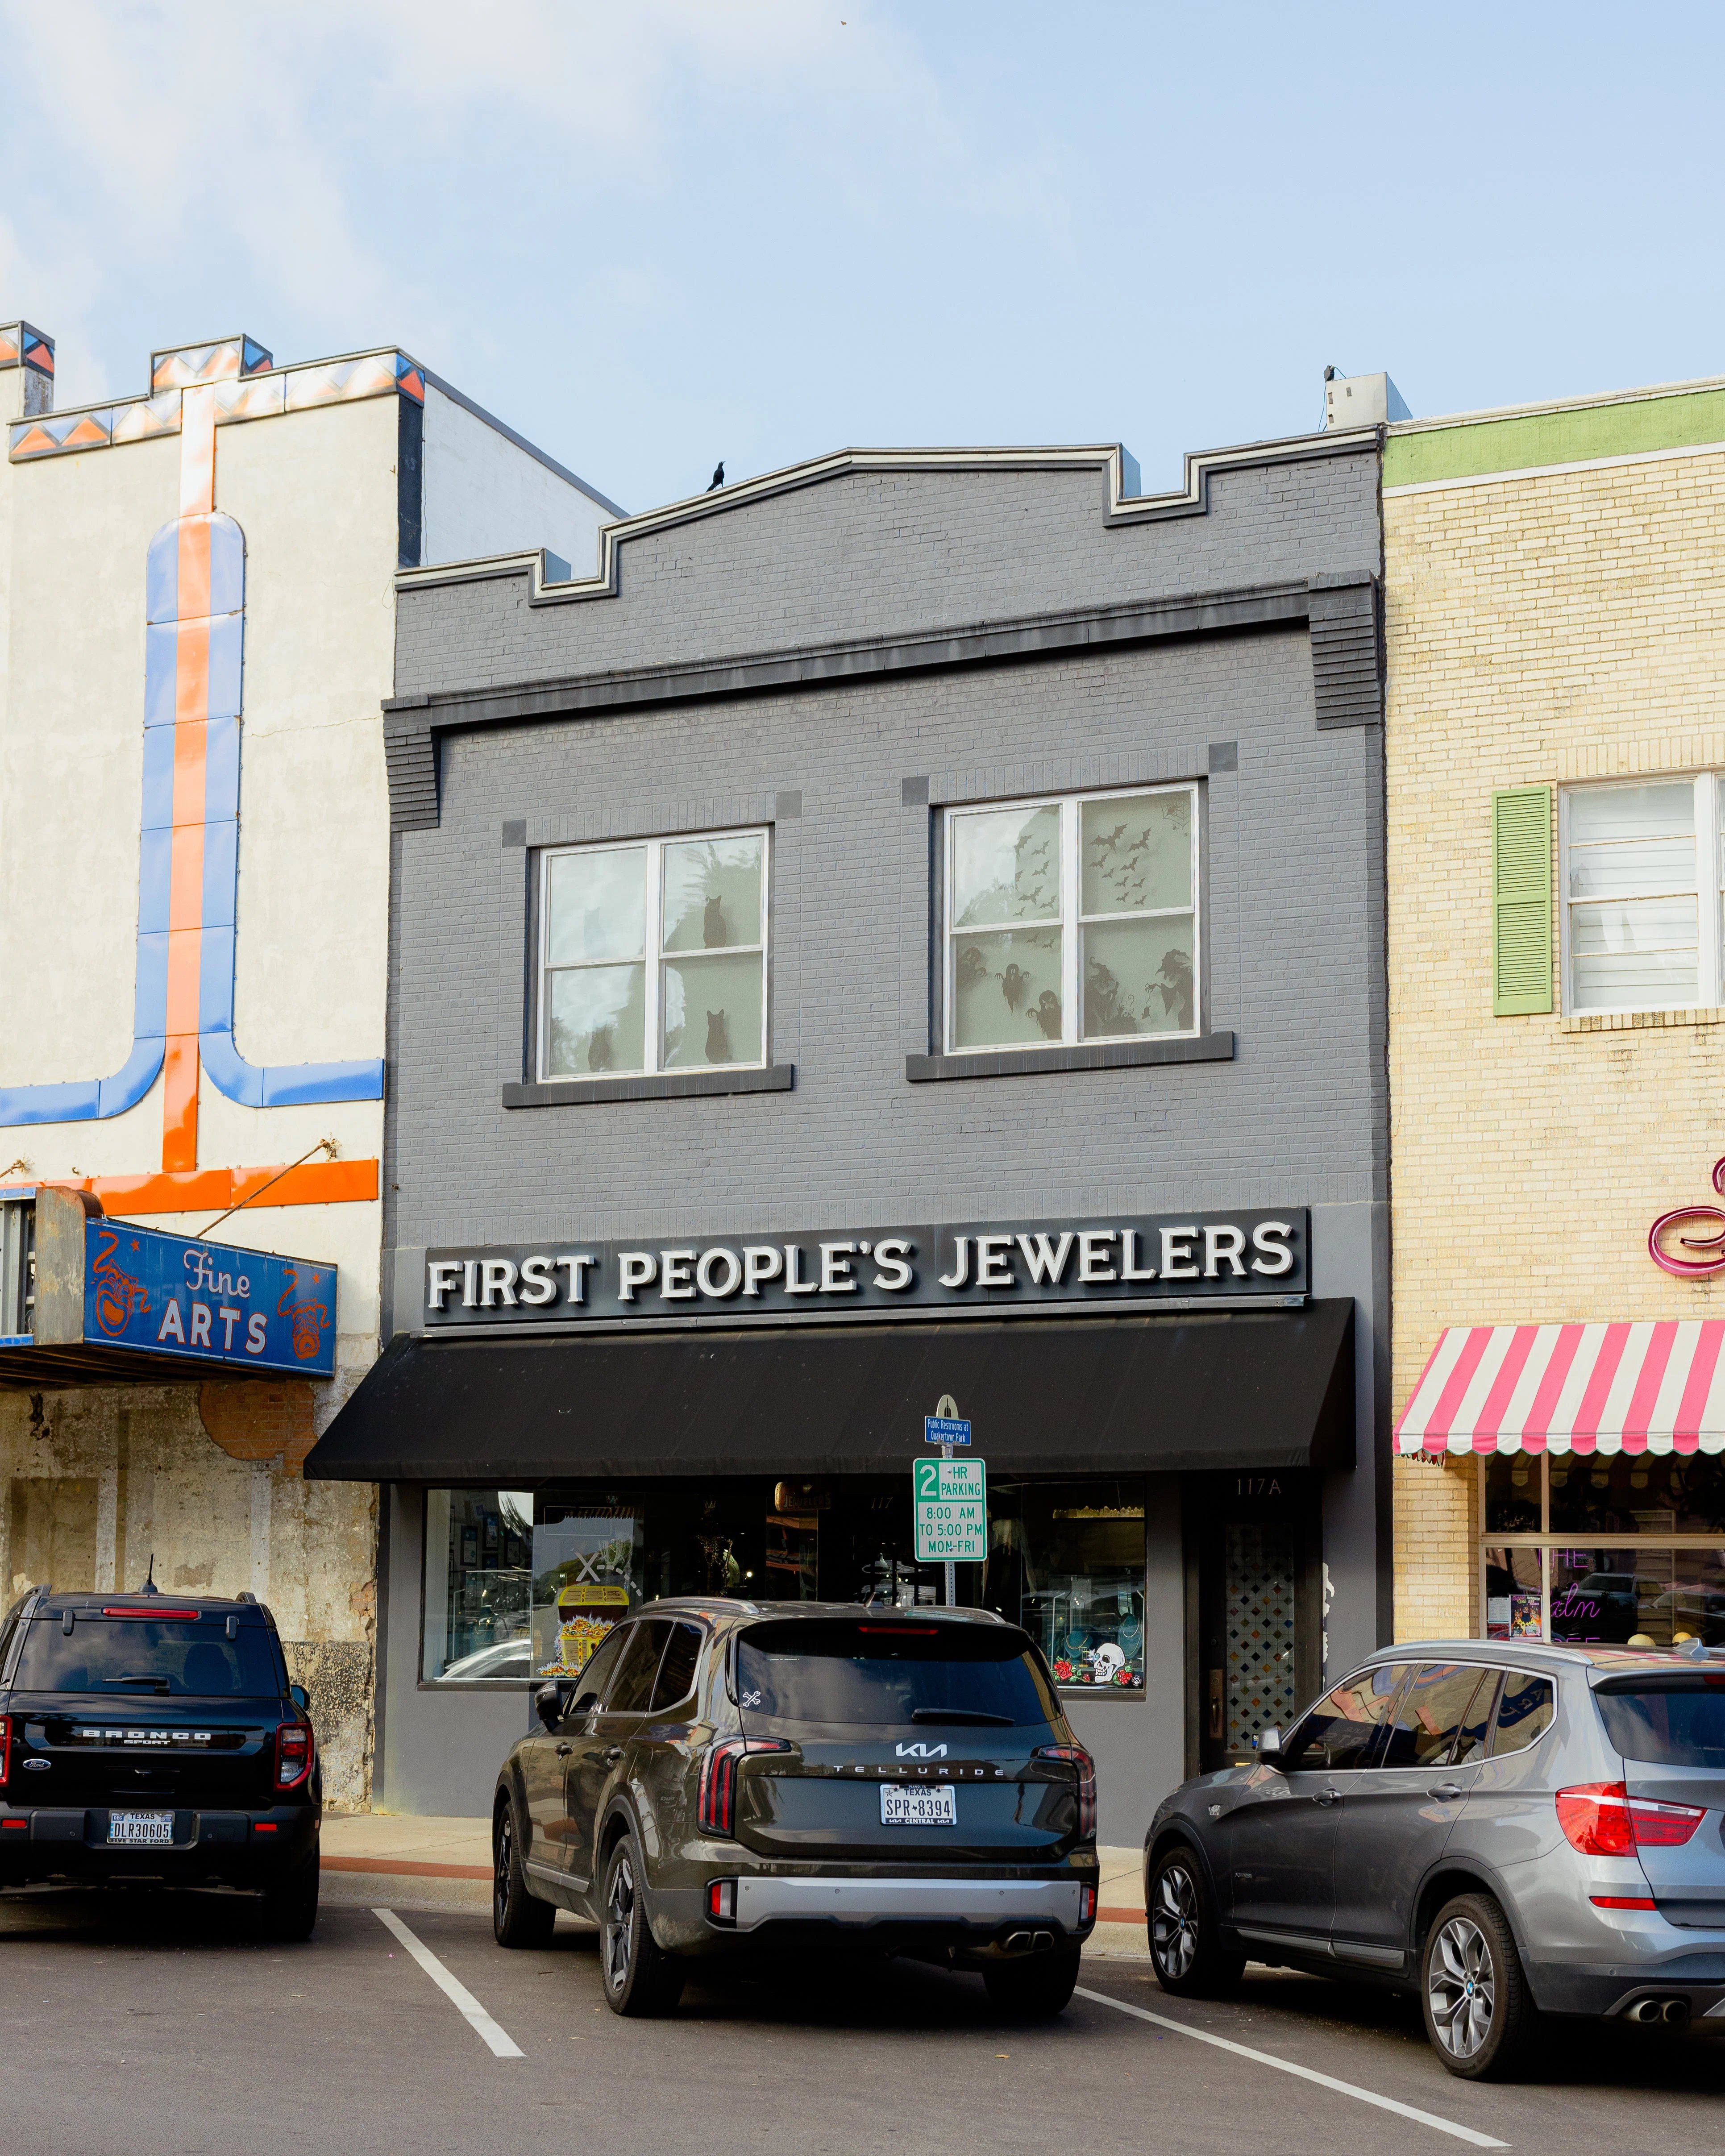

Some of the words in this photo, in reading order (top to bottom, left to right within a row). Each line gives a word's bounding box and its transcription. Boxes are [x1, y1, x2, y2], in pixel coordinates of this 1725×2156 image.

[428, 1255, 594, 1309] FIRST
[617, 1239, 912, 1300] PEOPLE'S
[938, 1221, 1293, 1288] JEWELERS
[183, 1249, 251, 1299] Fine
[157, 1298, 268, 1355] ARTS
[927, 1419, 939, 1429] Public
[941, 1420, 963, 1431] Restrooms
[964, 1422, 968, 1432] at
[931, 1430, 955, 1441] Quakertown
[956, 1433, 965, 1443] Park
[919, 1464, 937, 1496] 2
[952, 1466, 968, 1479] HR
[1237, 1478, 1282, 1495] 117A
[941, 1483, 981, 1496] PARKING
[871, 1496, 893, 1509] 117
[927, 1507, 952, 1520] 8:00
[959, 1507, 975, 1519] AM
[919, 1523, 933, 1536] TO
[937, 1524, 962, 1536] 5:00
[966, 1523, 982, 1536] PM
[928, 1540, 975, 1553] MON-FRI
[1530, 1583, 1600, 1618] alm
[83, 1730, 211, 1740] BRONCO
[896, 1743, 947, 1757] KIA
[833, 1766, 1004, 1776] TELLURIDE
[114, 1823, 169, 1838] DLR30605
